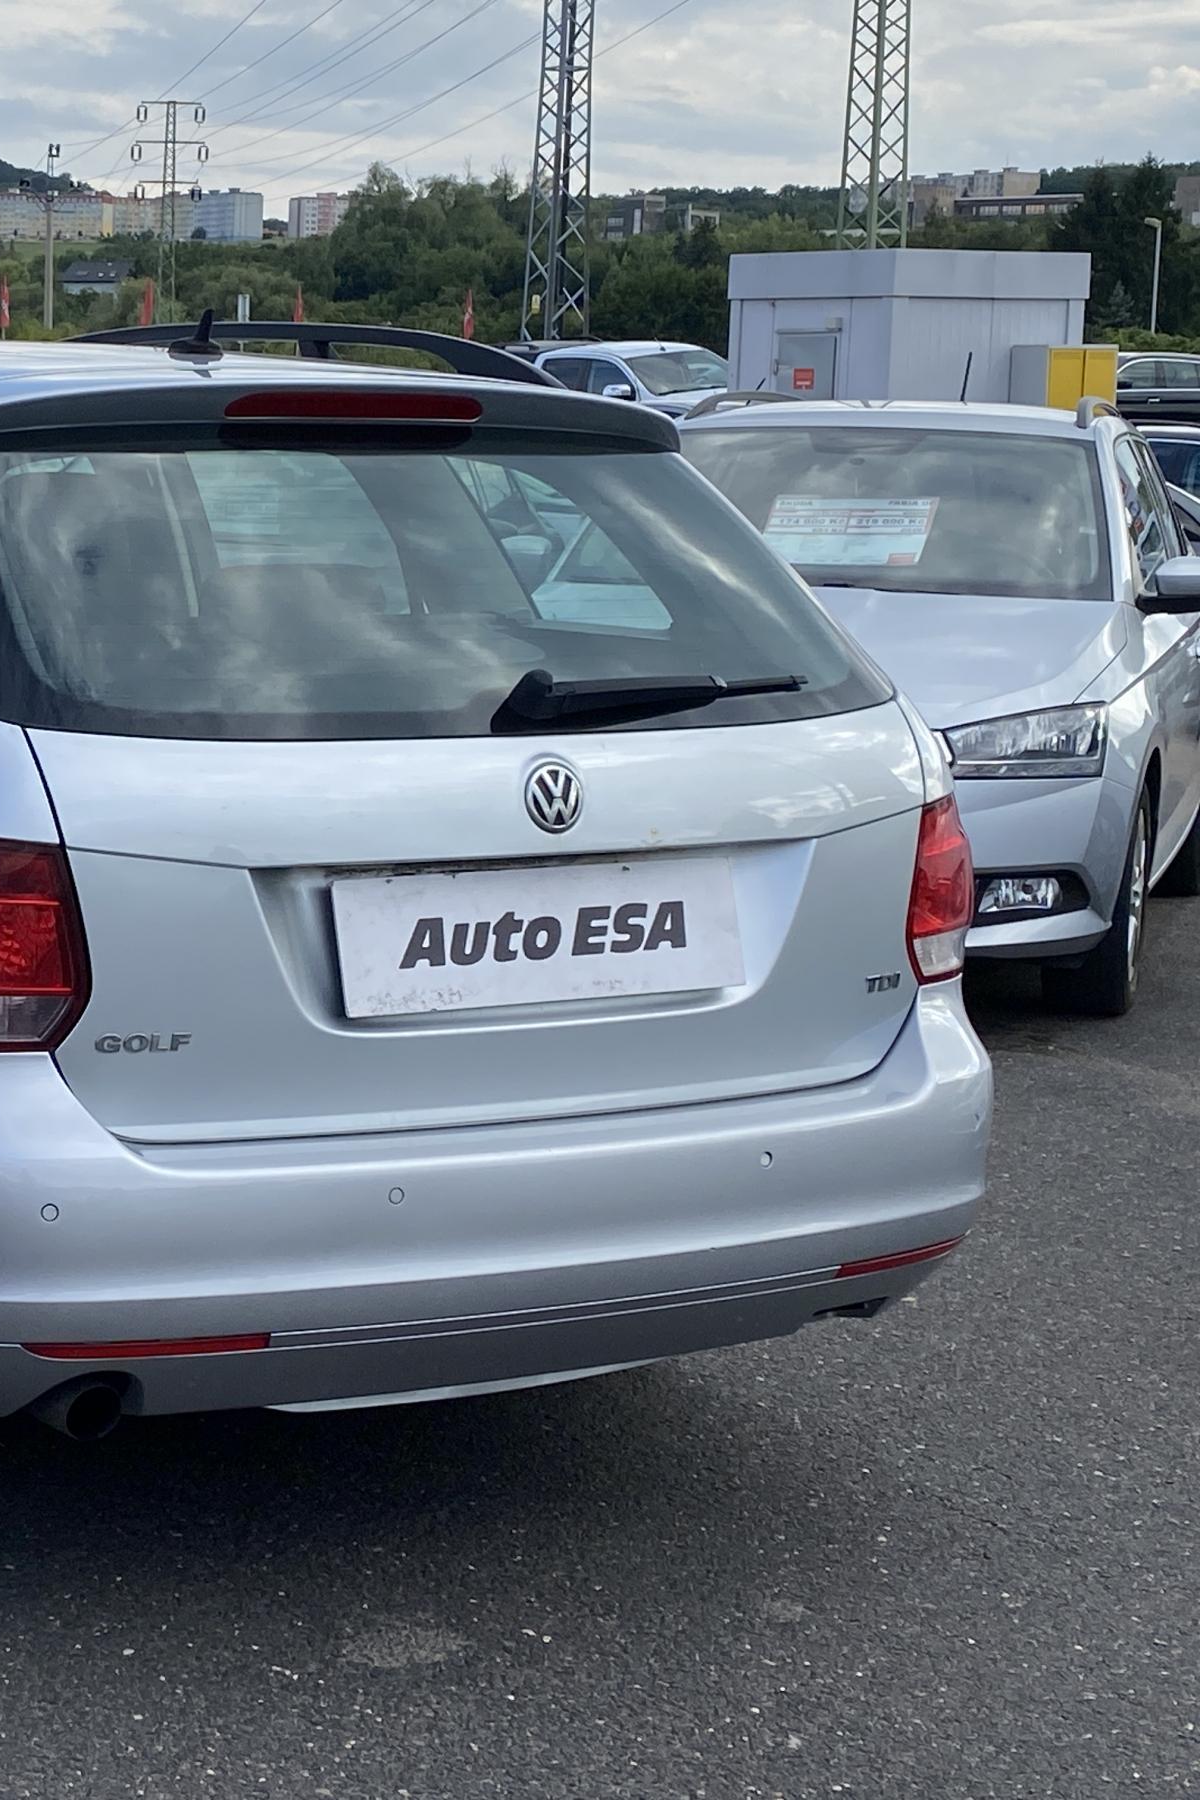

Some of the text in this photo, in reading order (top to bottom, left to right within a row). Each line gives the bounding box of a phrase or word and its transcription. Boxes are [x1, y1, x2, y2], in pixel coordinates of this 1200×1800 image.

[399, 901, 687, 969] Auto ESA
[865, 971, 901, 993] TDI
[94, 1032, 192, 1054] GOLF
